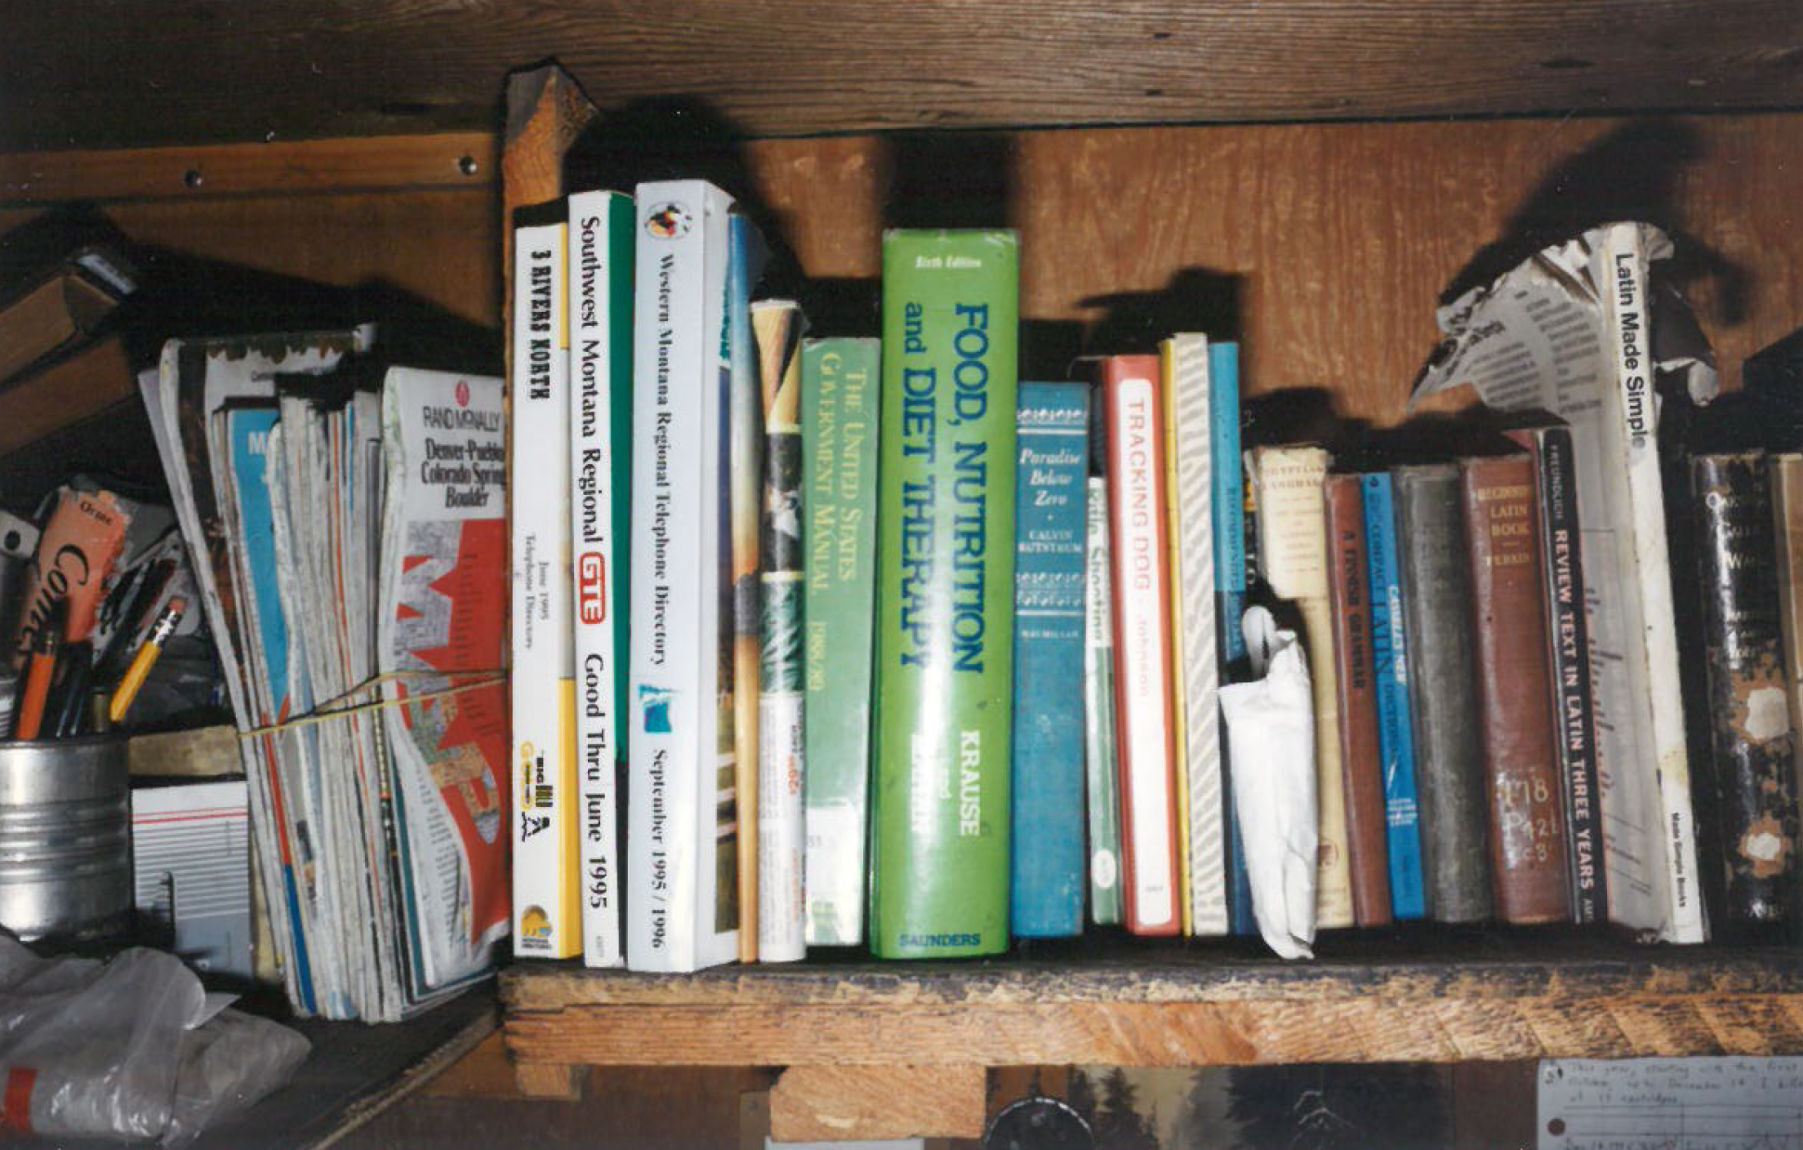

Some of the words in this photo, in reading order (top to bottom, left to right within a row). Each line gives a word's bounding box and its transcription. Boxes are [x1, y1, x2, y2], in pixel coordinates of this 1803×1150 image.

[530, 250, 551, 260] 3
[579, 215, 601, 329] Southwest
[1615, 253, 1634, 307] Latin
[529, 265, 551, 332] RIVERS
[657, 254, 675, 323] Western
[904, 302, 928, 354] and
[1620, 312, 1639, 370] Made
[529, 339, 551, 400] NORTH
[580, 340, 602, 438] Montana
[656, 328, 673, 406] Montana
[844, 369, 868, 413] THE
[946, 302, 990, 427] FOOD,
[422, 405, 454, 429] RAND
[814, 352, 843, 495] GOVERNMENT
[902, 367, 937, 464] DIET
[1625, 376, 1646, 450] Simple
[421, 460, 472, 485] Colorado
[653, 413, 673, 487] Regional
[839, 421, 866, 500] UNITED
[1019, 447, 1080, 465] Paradise
[1029, 468, 1073, 486] Below
[1127, 398, 1149, 528] TRACKING
[444, 485, 490, 509] Boulder
[578, 448, 603, 544] Regional
[1034, 489, 1069, 507] Zero
[1490, 503, 1528, 520] LATIN
[650, 494, 672, 580] Telephone
[811, 503, 836, 592] MANUAL
[838, 507, 862, 582] STATES
[951, 441, 988, 674] NUTRITION
[1491, 522, 1529, 537] BOOK
[582, 554, 602, 624] GTE
[900, 475, 935, 671] THERAPY
[1132, 535, 1151, 592] DOG
[1554, 529, 1573, 603] REVIEW
[649, 585, 670, 667] Directory
[1346, 613, 1366, 690] GRAMMAR
[1371, 600, 1394, 675] LATIN
[1560, 611, 1578, 658] TEXT
[585, 653, 606, 719] Good
[1564, 665, 1580, 686] IN
[1566, 695, 1585, 752] LATIN
[536, 757, 545, 785] BIG
[585, 729, 606, 782] Thru
[959, 729, 981, 837] KRAUSE
[584, 792, 606, 843] June
[648, 749, 670, 845] September
[1571, 758, 1590, 821] THREE
[587, 854, 608, 910] 1995
[651, 850, 668, 892] 1995
[1575, 827, 1595, 890] YEARS
[651, 907, 668, 949] 1996
[899, 933, 981, 948] SAUNDERS
